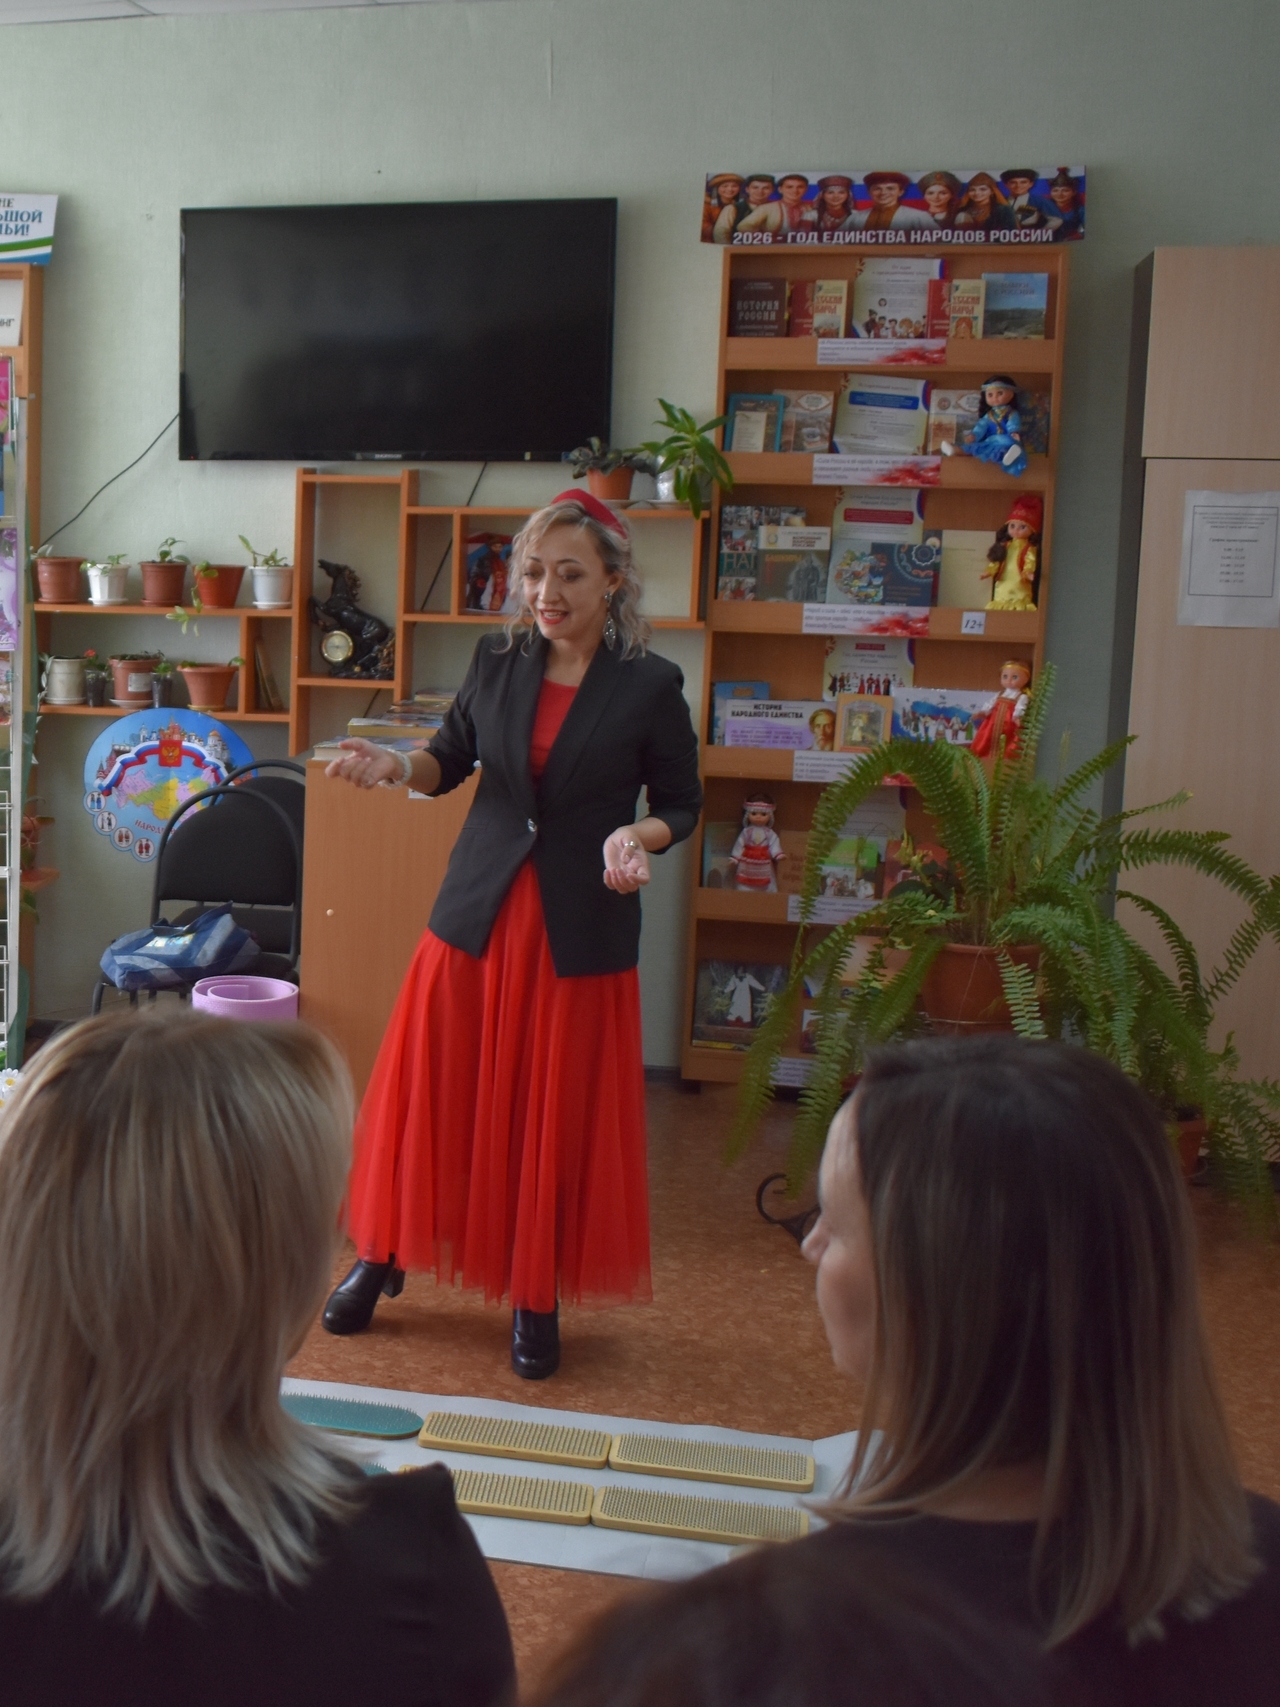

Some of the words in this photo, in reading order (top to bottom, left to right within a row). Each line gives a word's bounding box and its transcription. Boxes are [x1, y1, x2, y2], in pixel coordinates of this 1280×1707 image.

[732, 231, 773, 245] 2026
[787, 231, 819, 245] ГОД
[822, 230, 906, 244] ЕДИНСТВА
[910, 229, 986, 244] НАРОДОВ
[990, 228, 1054, 243] РОССИИ
[736, 300, 779, 311] ИСТОРИЯ
[738, 311, 776, 321] РОССИИ
[963, 618, 983, 630] 12+
[730, 710, 769, 718] НАРОДНОГО
[770, 711, 804, 719] ЕДИНСТВА
